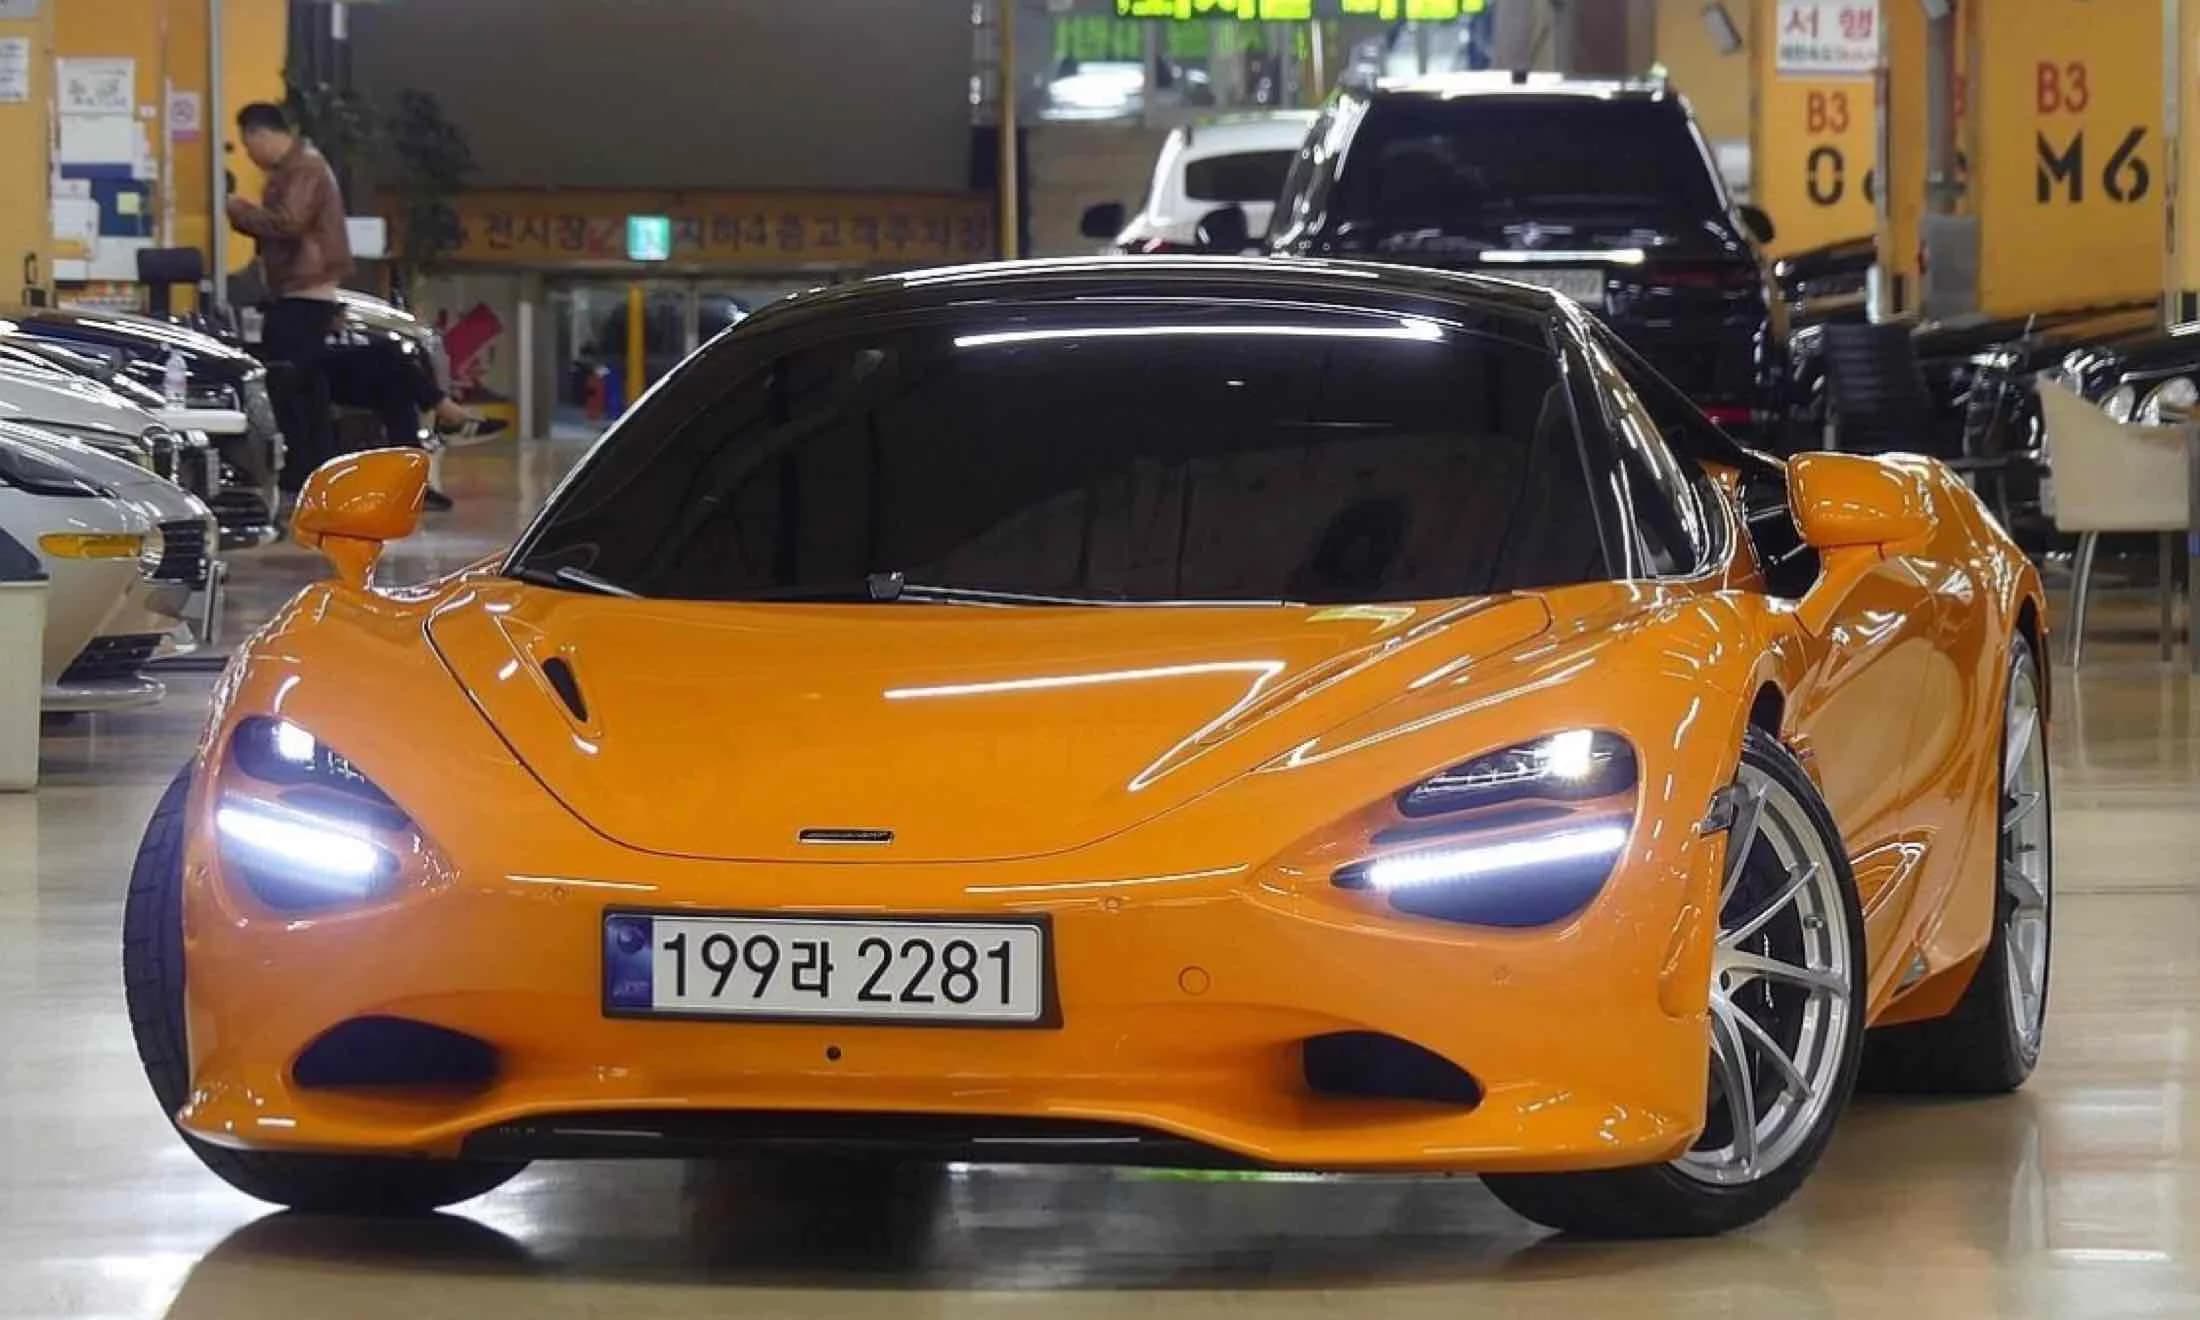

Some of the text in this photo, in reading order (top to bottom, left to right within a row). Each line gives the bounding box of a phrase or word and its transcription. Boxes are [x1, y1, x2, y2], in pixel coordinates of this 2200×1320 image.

[1807, 92, 1849, 134] B3
[2036, 62, 2088, 114] B3
[664, 932, 1012, 1005] 199라 2281
